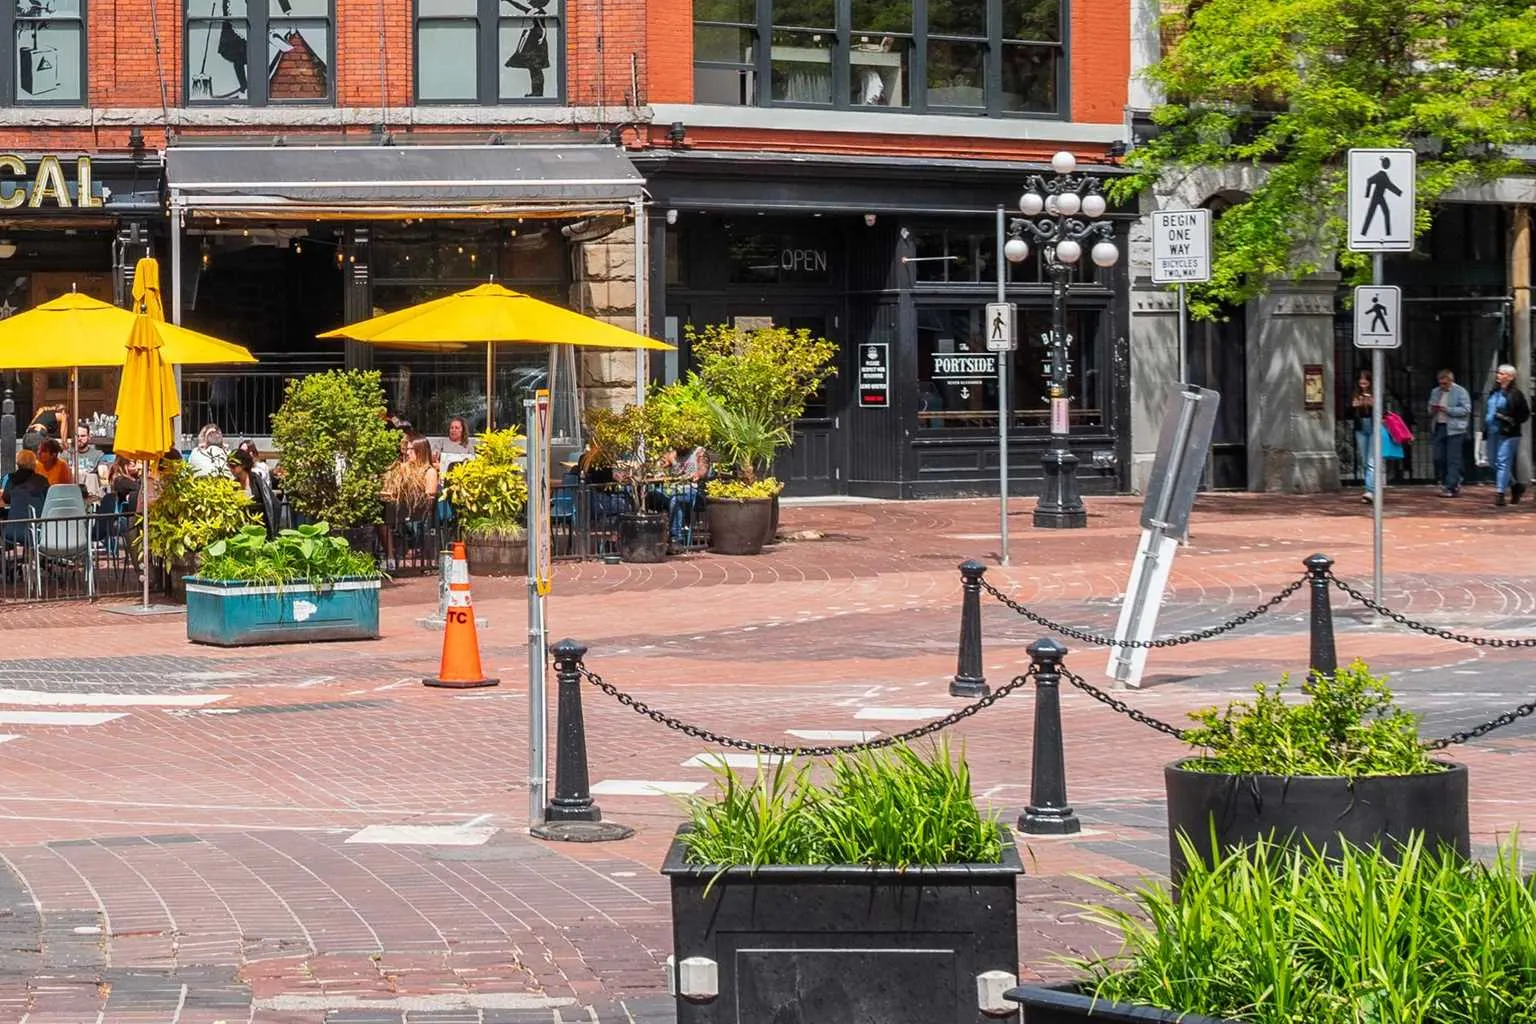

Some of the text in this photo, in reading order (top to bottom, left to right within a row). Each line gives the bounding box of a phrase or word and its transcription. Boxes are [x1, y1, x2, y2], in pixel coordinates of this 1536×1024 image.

[1162, 214, 1197, 227] BEGIN
[1168, 229, 1191, 241] ONE
[1169, 243, 1190, 255] WAY
[781, 248, 827, 272] OPEN
[1162, 259, 1198, 269] BICYCLES
[1164, 269, 1180, 277] TWO
[934, 357, 995, 373] PORTSIDE
